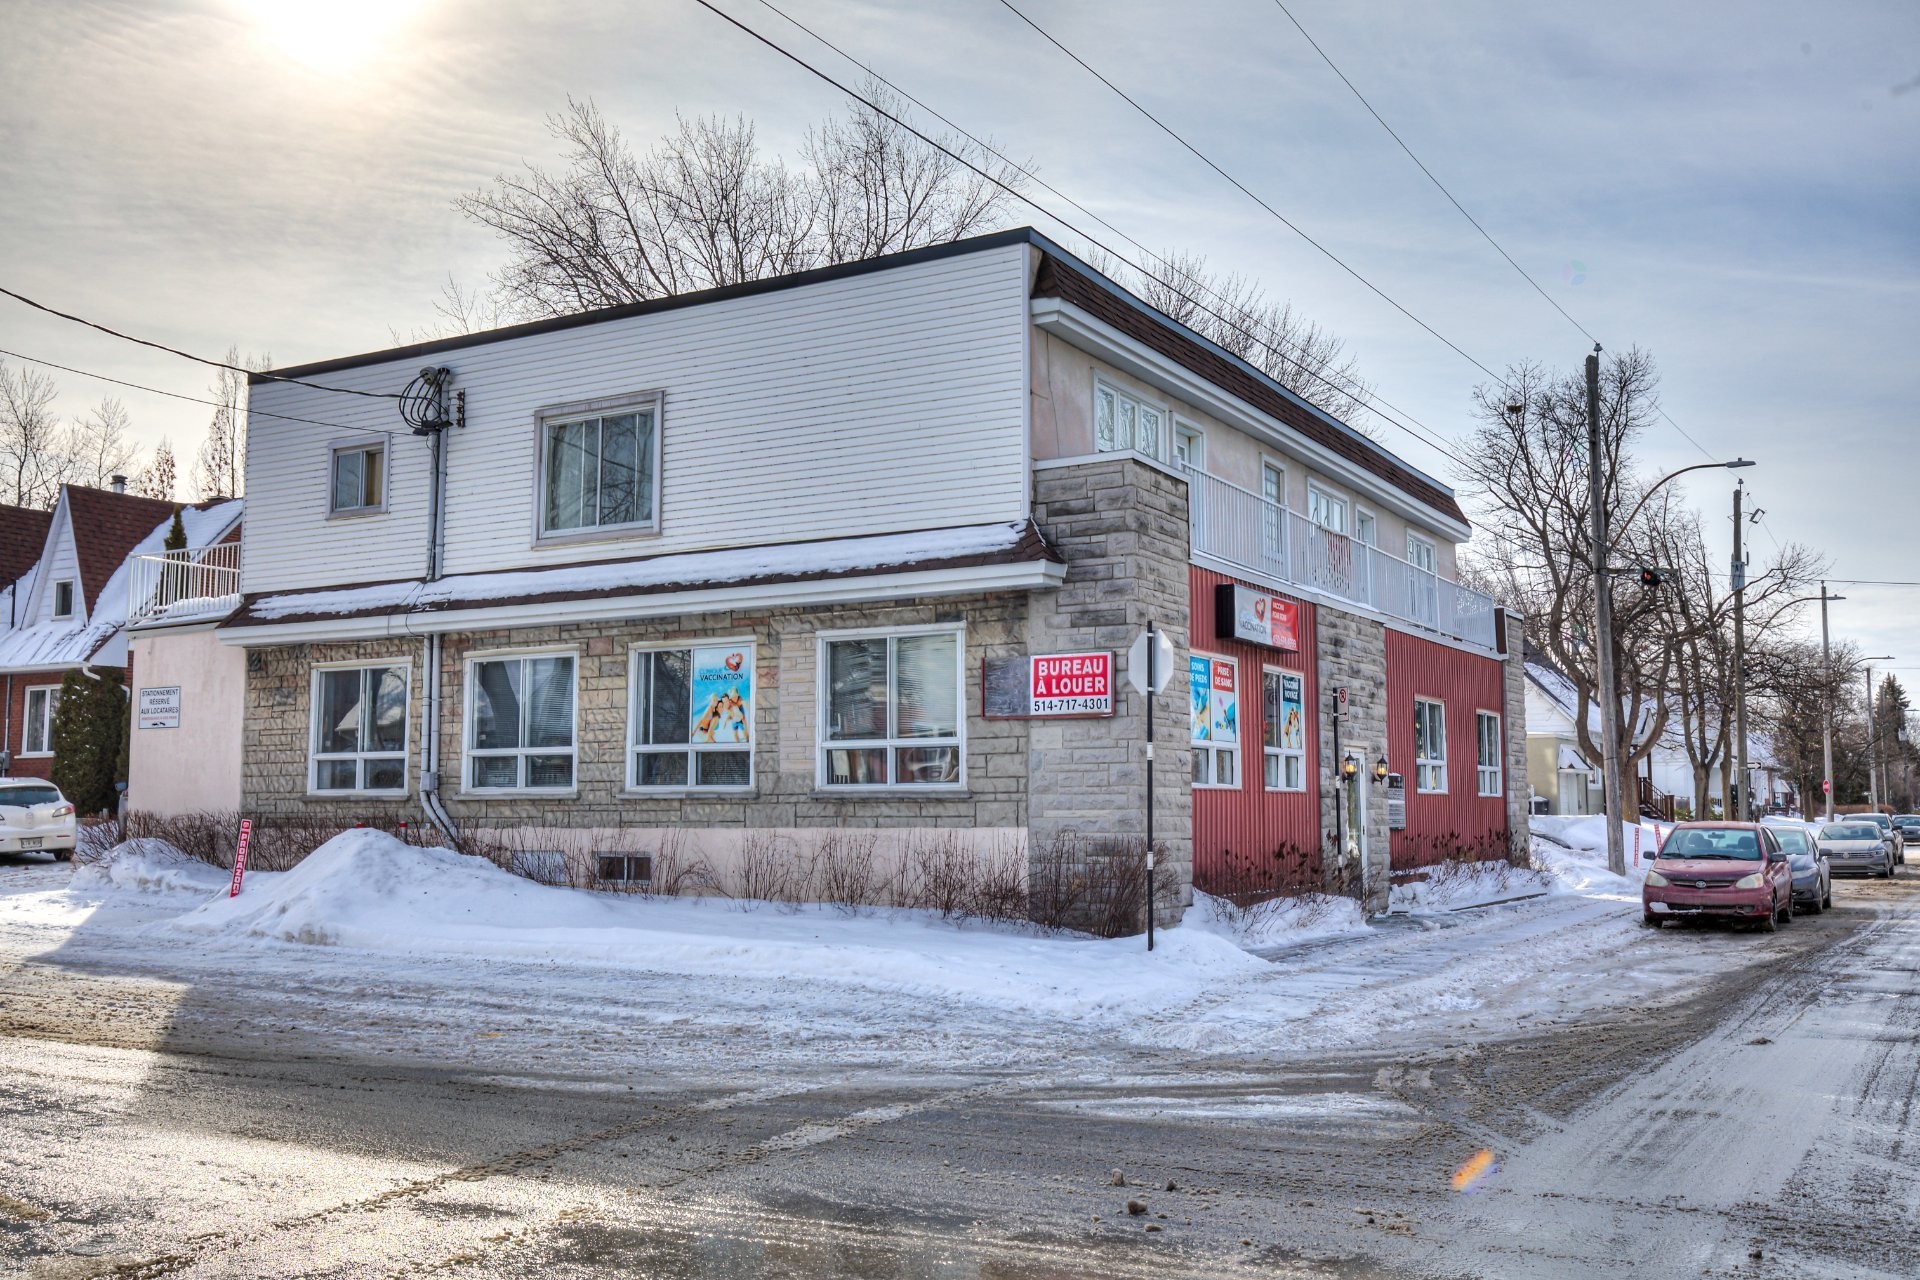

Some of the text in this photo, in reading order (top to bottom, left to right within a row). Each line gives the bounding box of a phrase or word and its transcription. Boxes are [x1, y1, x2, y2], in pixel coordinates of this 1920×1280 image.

[1038, 658, 1104, 677] BUREAU
[1191, 662, 1205, 672] SOINS
[1217, 665, 1230, 677] PRISE
[700, 673, 744, 681] VACCINATION
[1195, 673, 1208, 684] PIEDS
[1214, 676, 1221, 686] DE
[1036, 676, 1105, 695] À LOUER
[141, 688, 179, 697] STATIONNEMENT
[149, 697, 170, 705] RÉSERVÉ
[1034, 698, 1108, 712] 514-717-4301
[150, 706, 179, 714] LOCATAIRES
